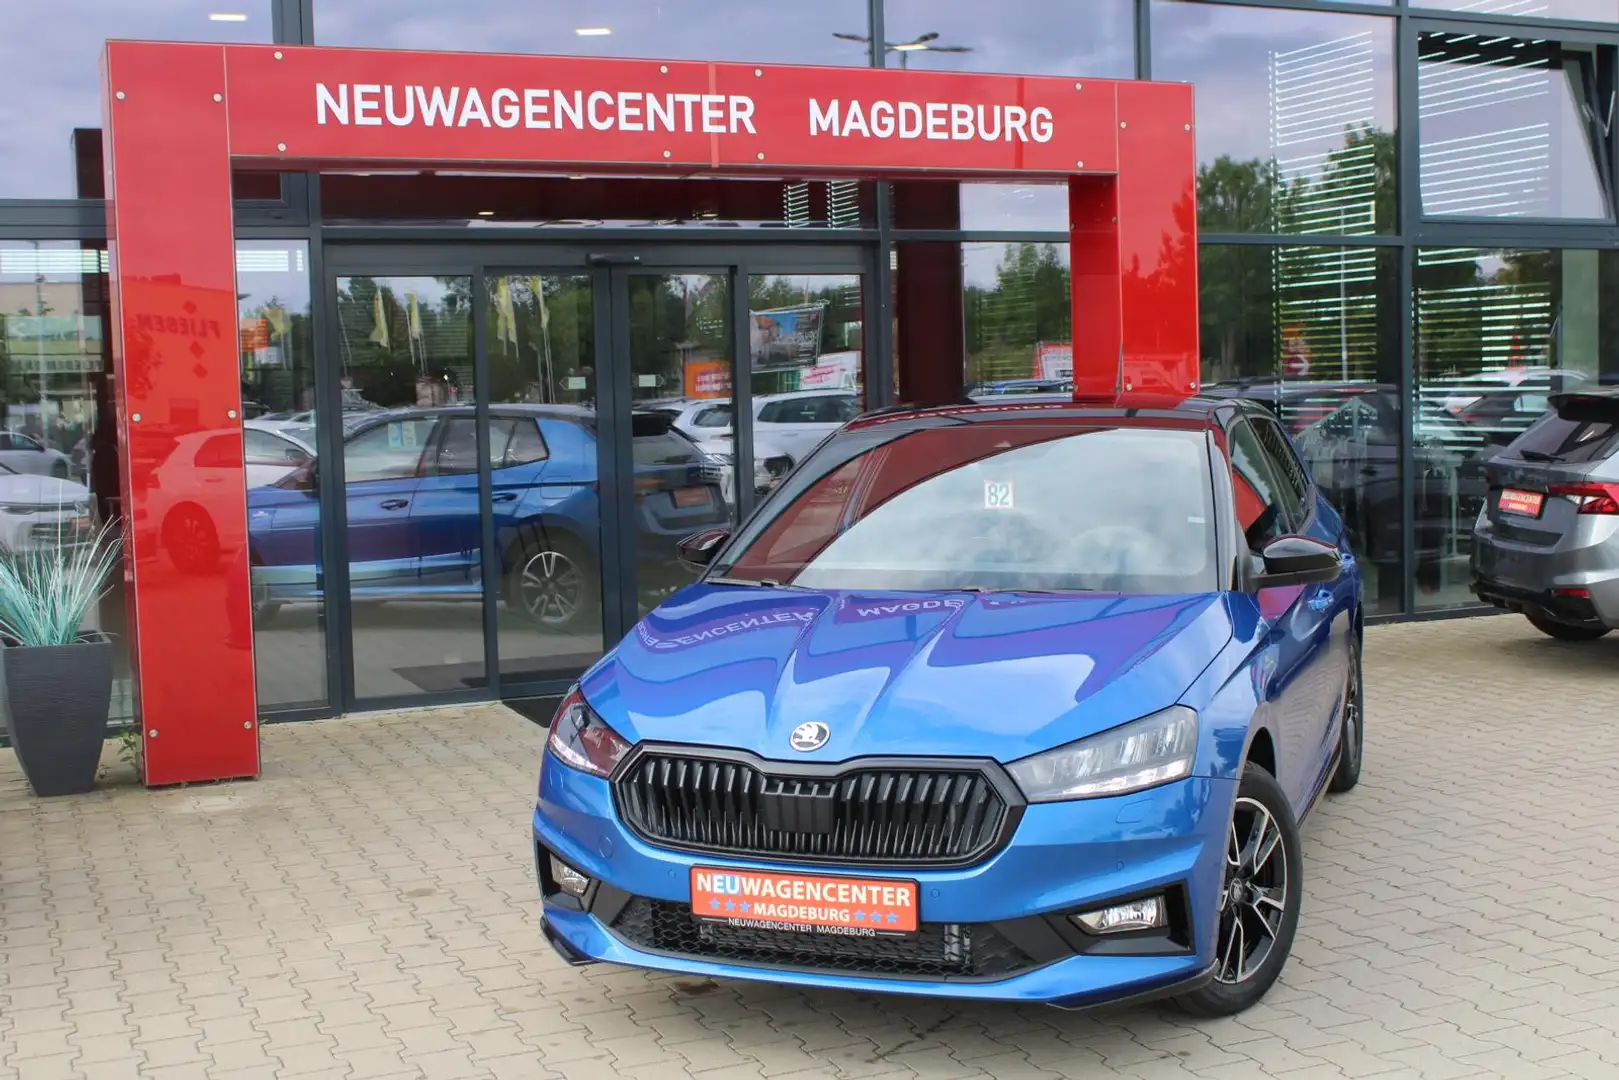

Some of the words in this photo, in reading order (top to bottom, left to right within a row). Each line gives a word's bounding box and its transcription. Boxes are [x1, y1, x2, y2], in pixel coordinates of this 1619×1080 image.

[316, 82, 756, 135] NEUWAGENCENTER
[808, 98, 1054, 143] MAGDEBURG
[988, 484, 1010, 506] 82
[696, 873, 911, 907] NEUWAGENCENTER
[753, 902, 850, 922] MAGDEBURG
[728, 917, 812, 933] NEUWAGENCENTER
[816, 924, 876, 937] MAGDEBURG
